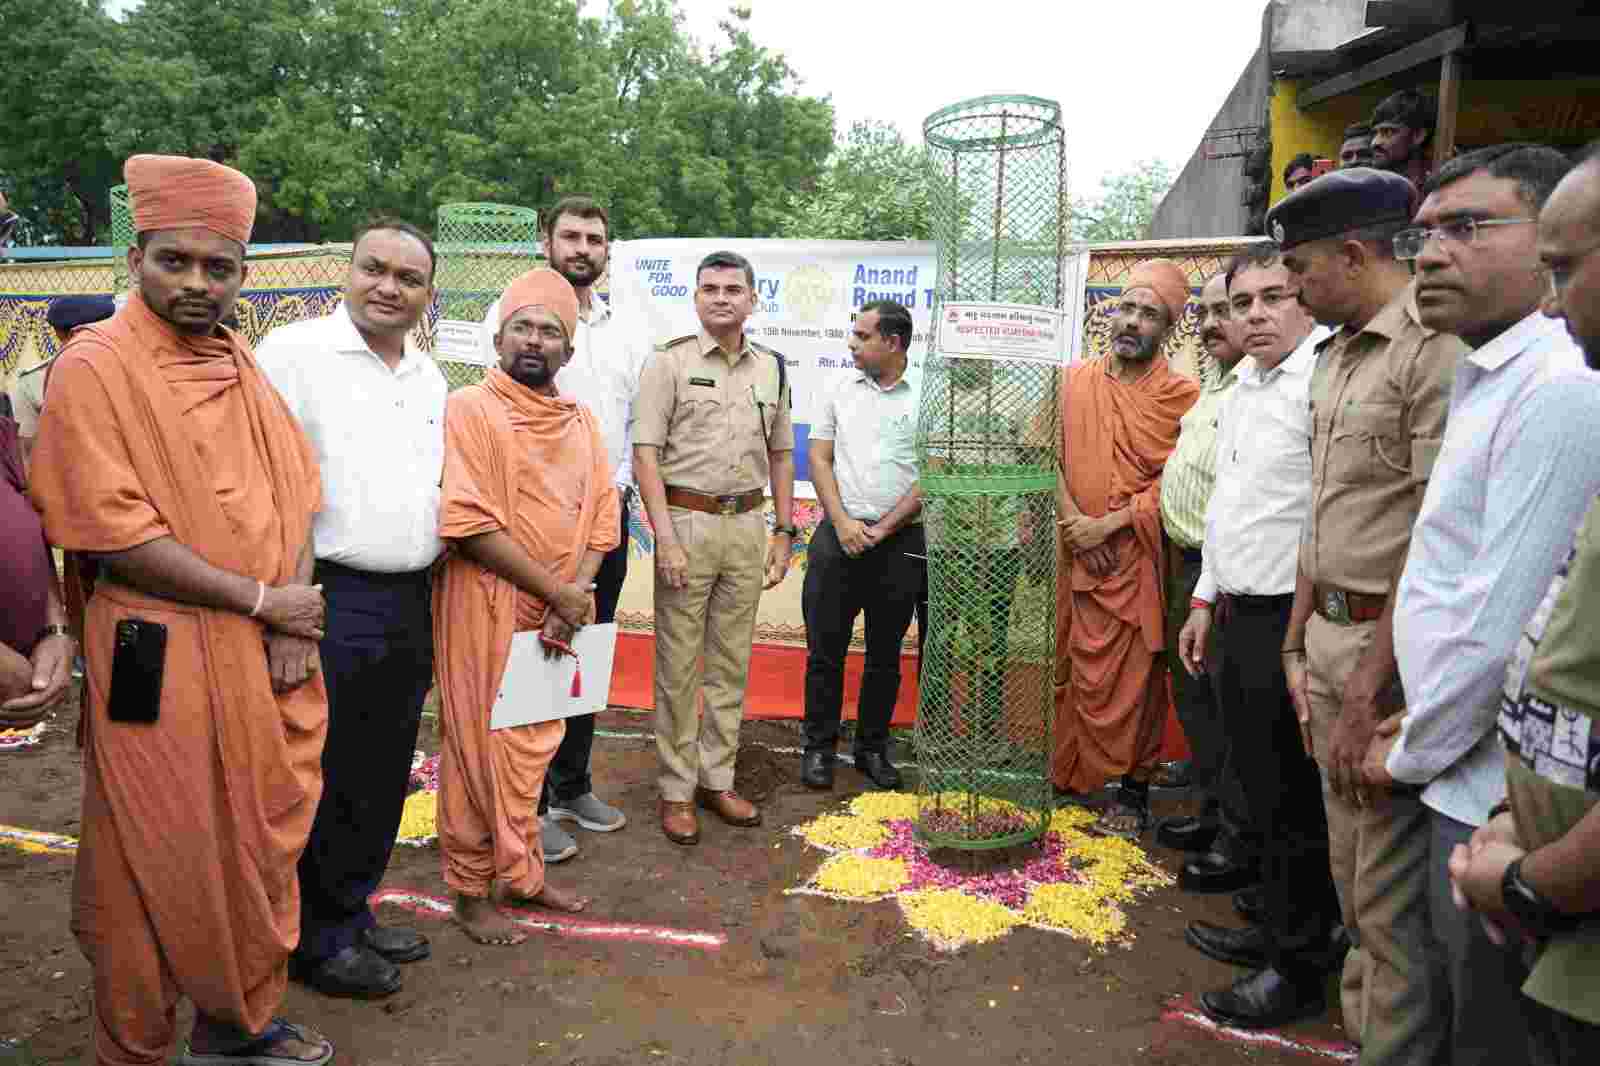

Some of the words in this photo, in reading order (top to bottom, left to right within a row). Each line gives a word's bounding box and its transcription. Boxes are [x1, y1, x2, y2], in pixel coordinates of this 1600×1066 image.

[634, 259, 672, 271] UNITE
[648, 272, 673, 284] FOR
[853, 263, 918, 286] Anand
[650, 286, 689, 297] GOOD
[853, 287, 917, 308] Round
[754, 302, 780, 313] lub
